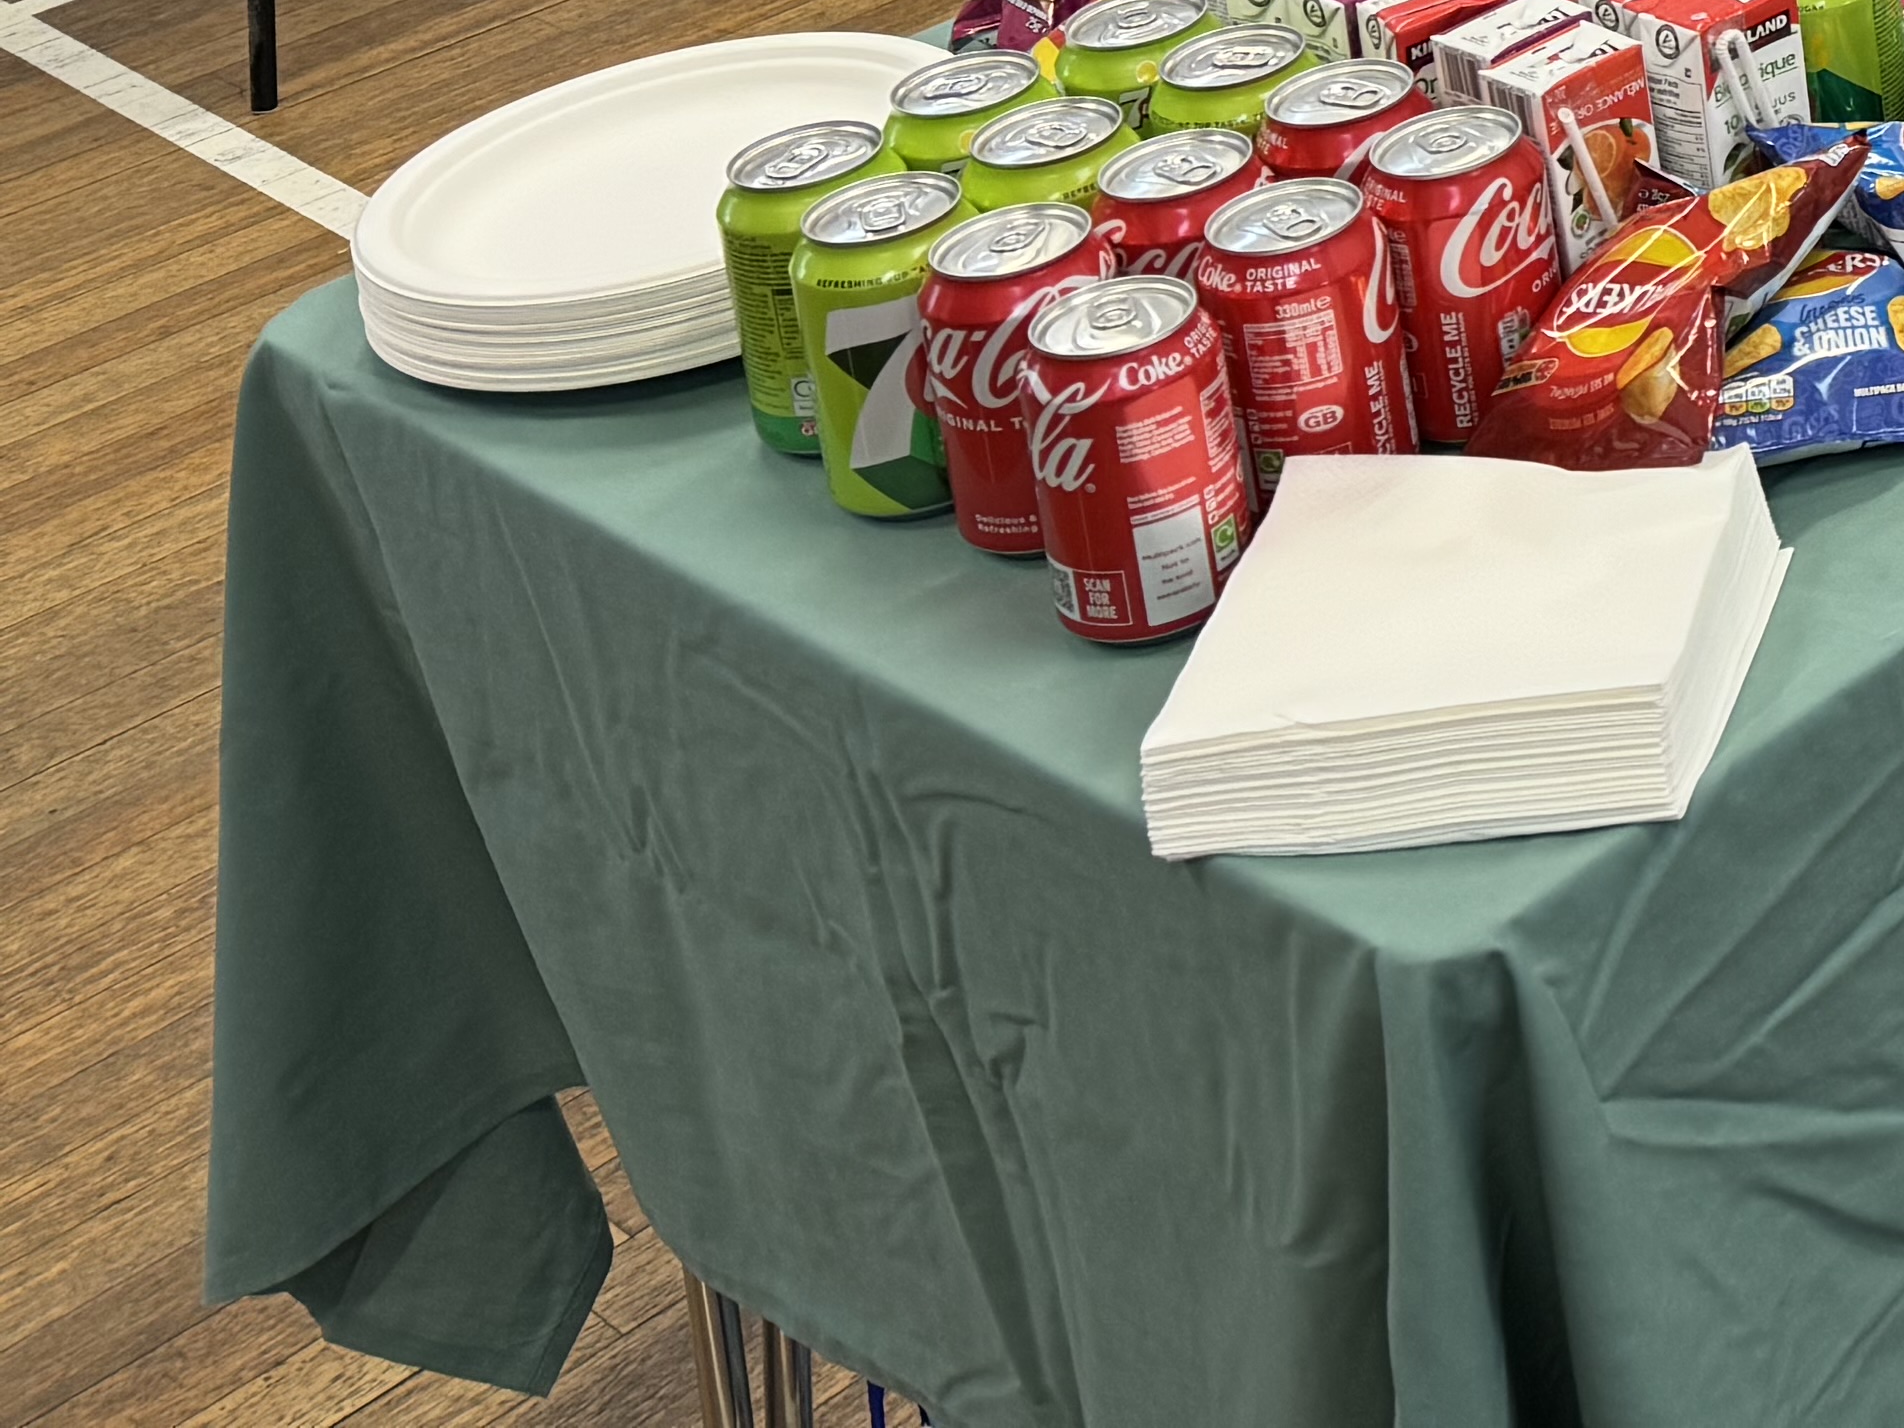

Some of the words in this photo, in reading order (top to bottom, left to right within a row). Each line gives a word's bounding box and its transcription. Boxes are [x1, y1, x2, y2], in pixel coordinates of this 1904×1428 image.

[1748, 14, 1789, 43] LAND
[1197, 254, 1237, 293] Coke
[1245, 257, 1322, 282] ORIGINAL
[1244, 276, 1298, 294] TASTE
[1439, 311, 1465, 347] ME
[1794, 304, 1881, 340] CHEESE
[1792, 337, 1812, 357] &
[1812, 325, 1890, 354] ONION
[1118, 350, 1185, 392] Coke
[1364, 360, 1386, 398] ME
[1446, 349, 1474, 431] RECYCLE
[1303, 409, 1340, 430] GB
[1083, 577, 1112, 593] SCAN
[1088, 591, 1111, 606] FOR
[1086, 605, 1119, 620] MORE
